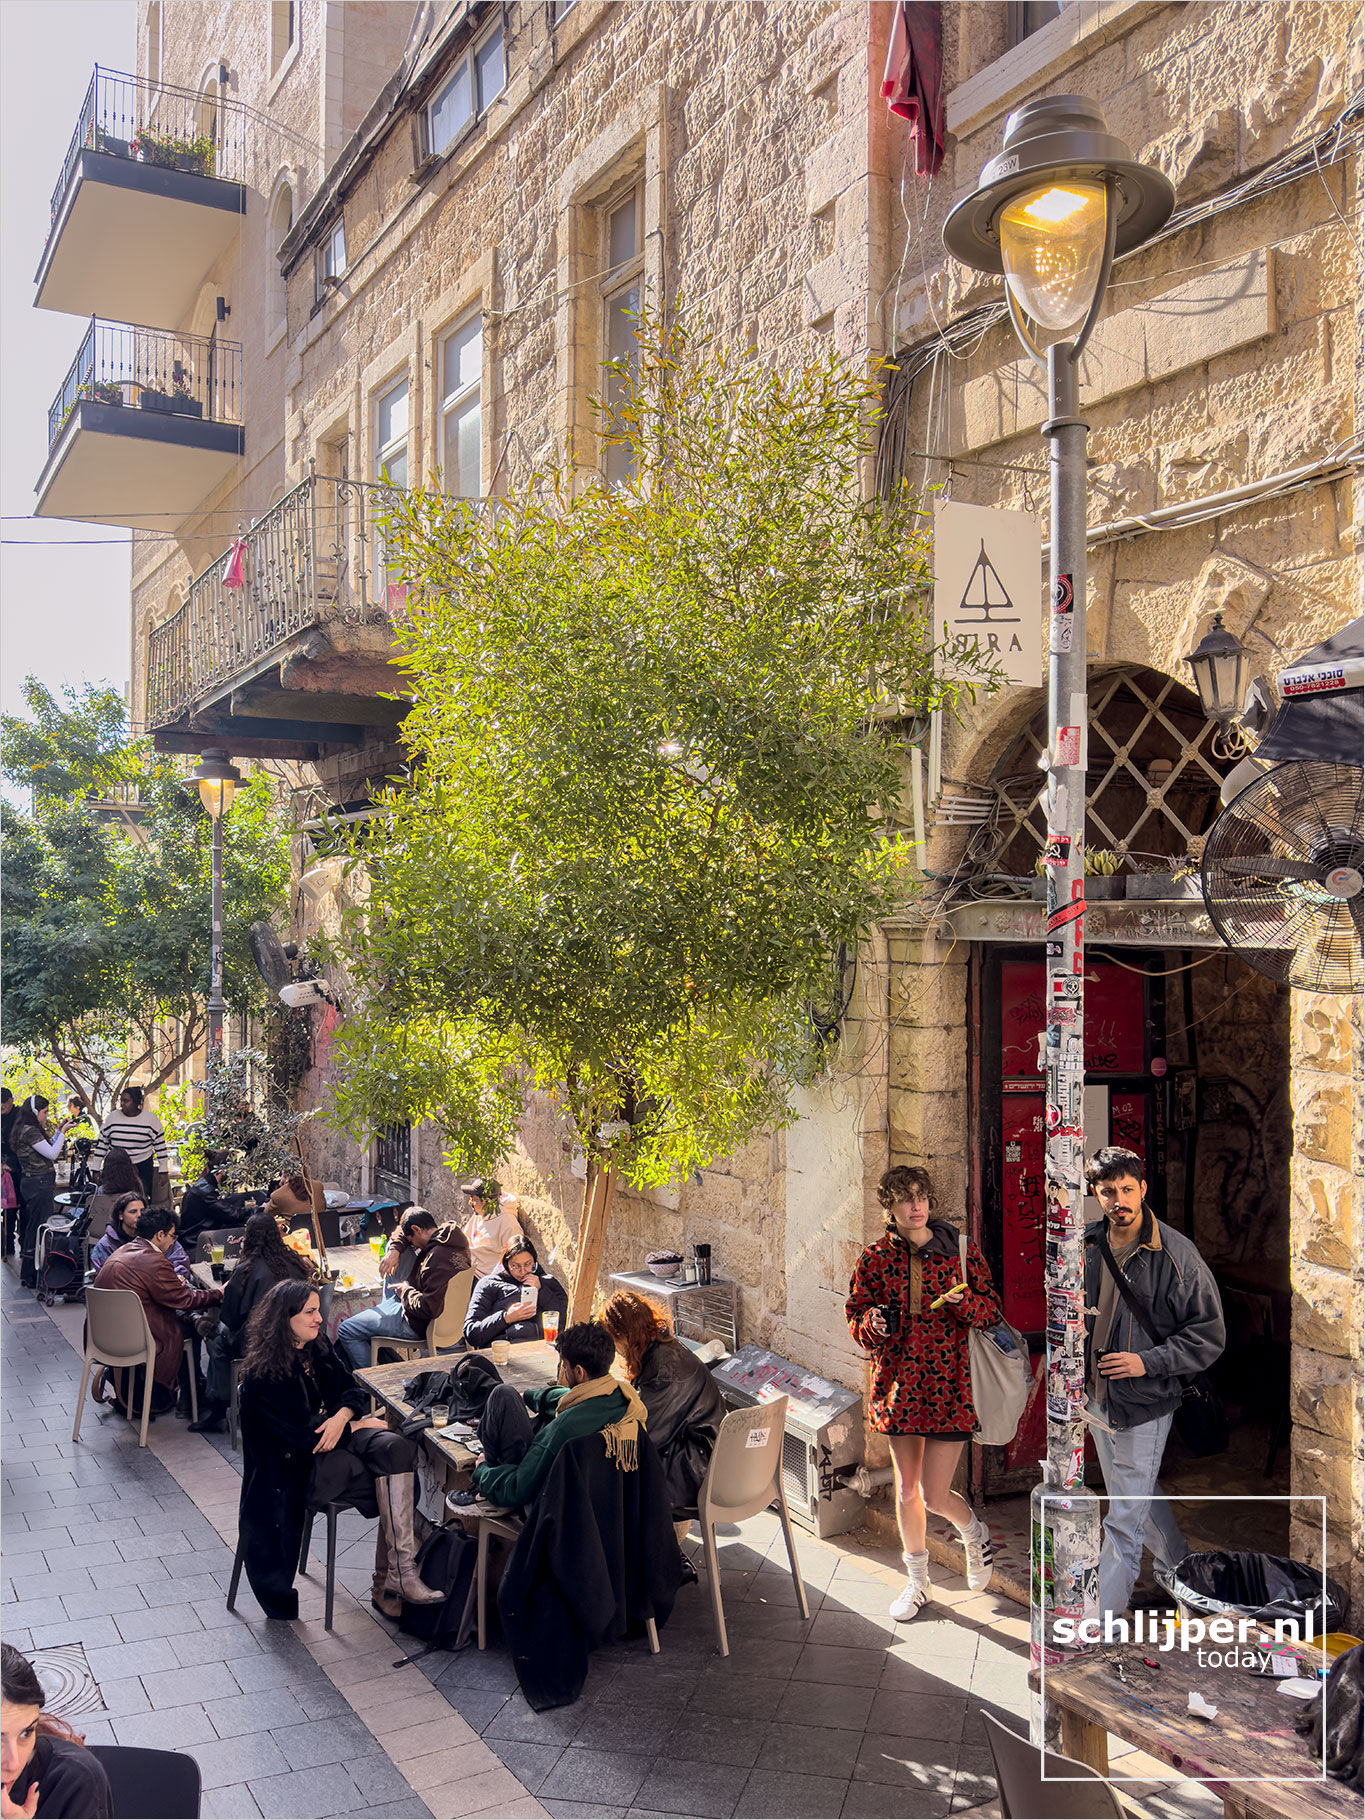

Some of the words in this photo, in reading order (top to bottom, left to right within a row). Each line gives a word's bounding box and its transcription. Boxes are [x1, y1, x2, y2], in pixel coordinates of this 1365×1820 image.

[999, 157, 1017, 175] 23W
[956, 632, 1023, 653] SIRA
[1283, 673, 1315, 685] אלברט
